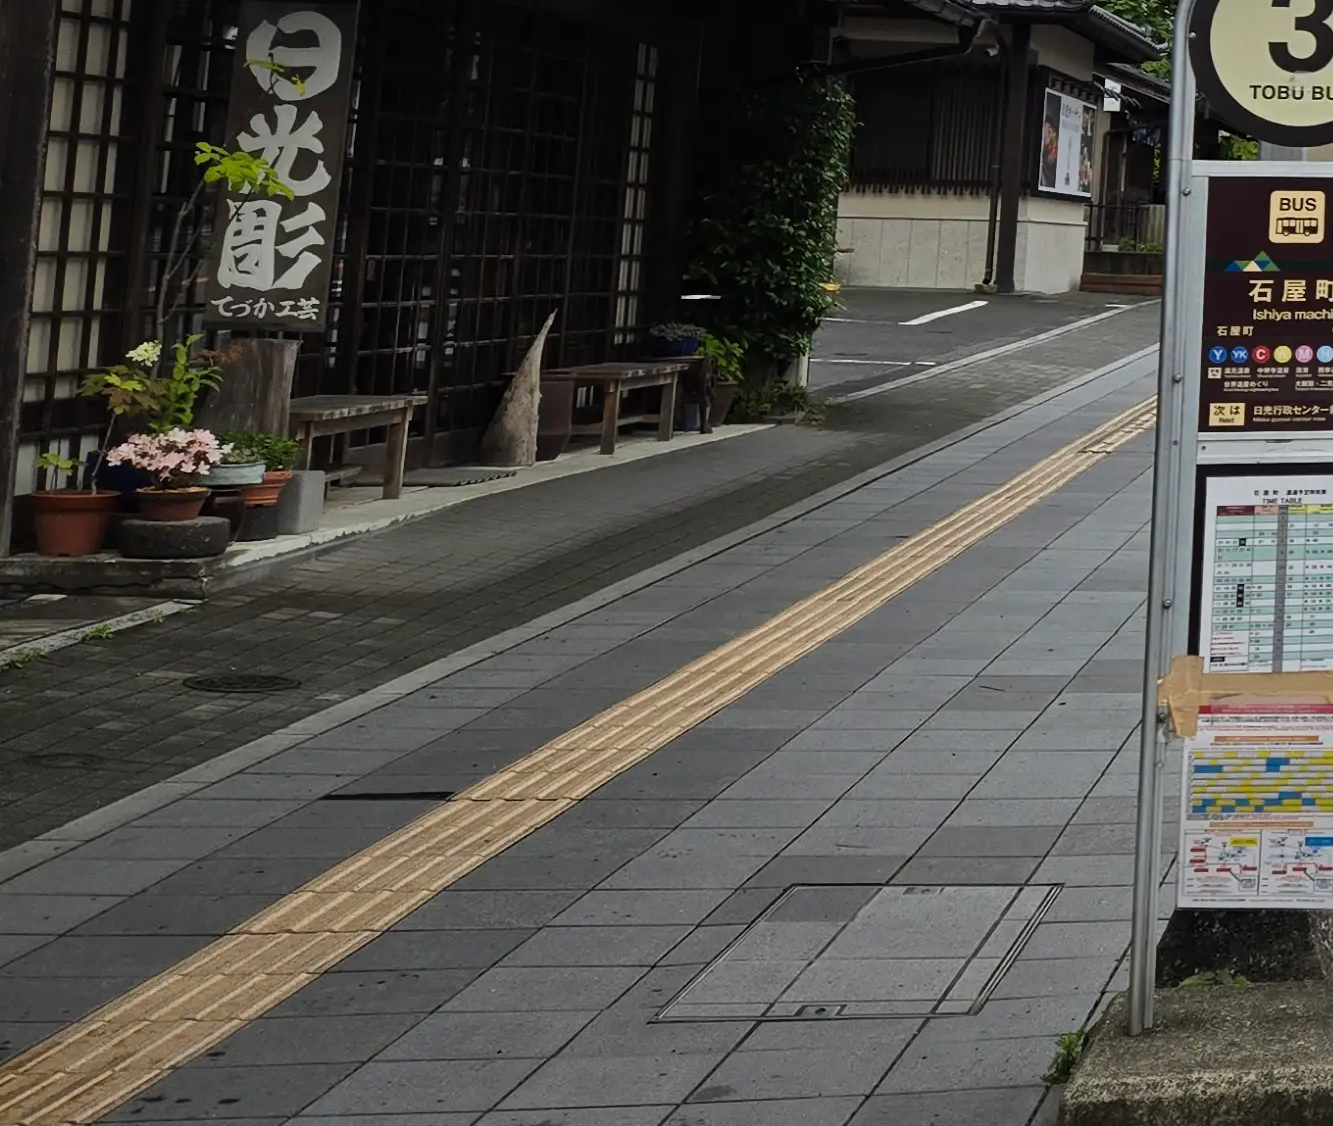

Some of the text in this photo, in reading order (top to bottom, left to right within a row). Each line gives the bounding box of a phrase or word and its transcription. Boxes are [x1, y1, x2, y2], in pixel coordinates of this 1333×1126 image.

[1249, 84, 1304, 101] TOBU
[1279, 198, 1317, 211] BUS
[210, 296, 322, 321] てづか工芸
[1253, 308, 1333, 321] Ishiya machi
[1217, 326, 1254, 336] 石屋町
[1232, 349, 1248, 359] YK
[1255, 348, 1267, 360] C
[1213, 405, 1241, 416] 次は
